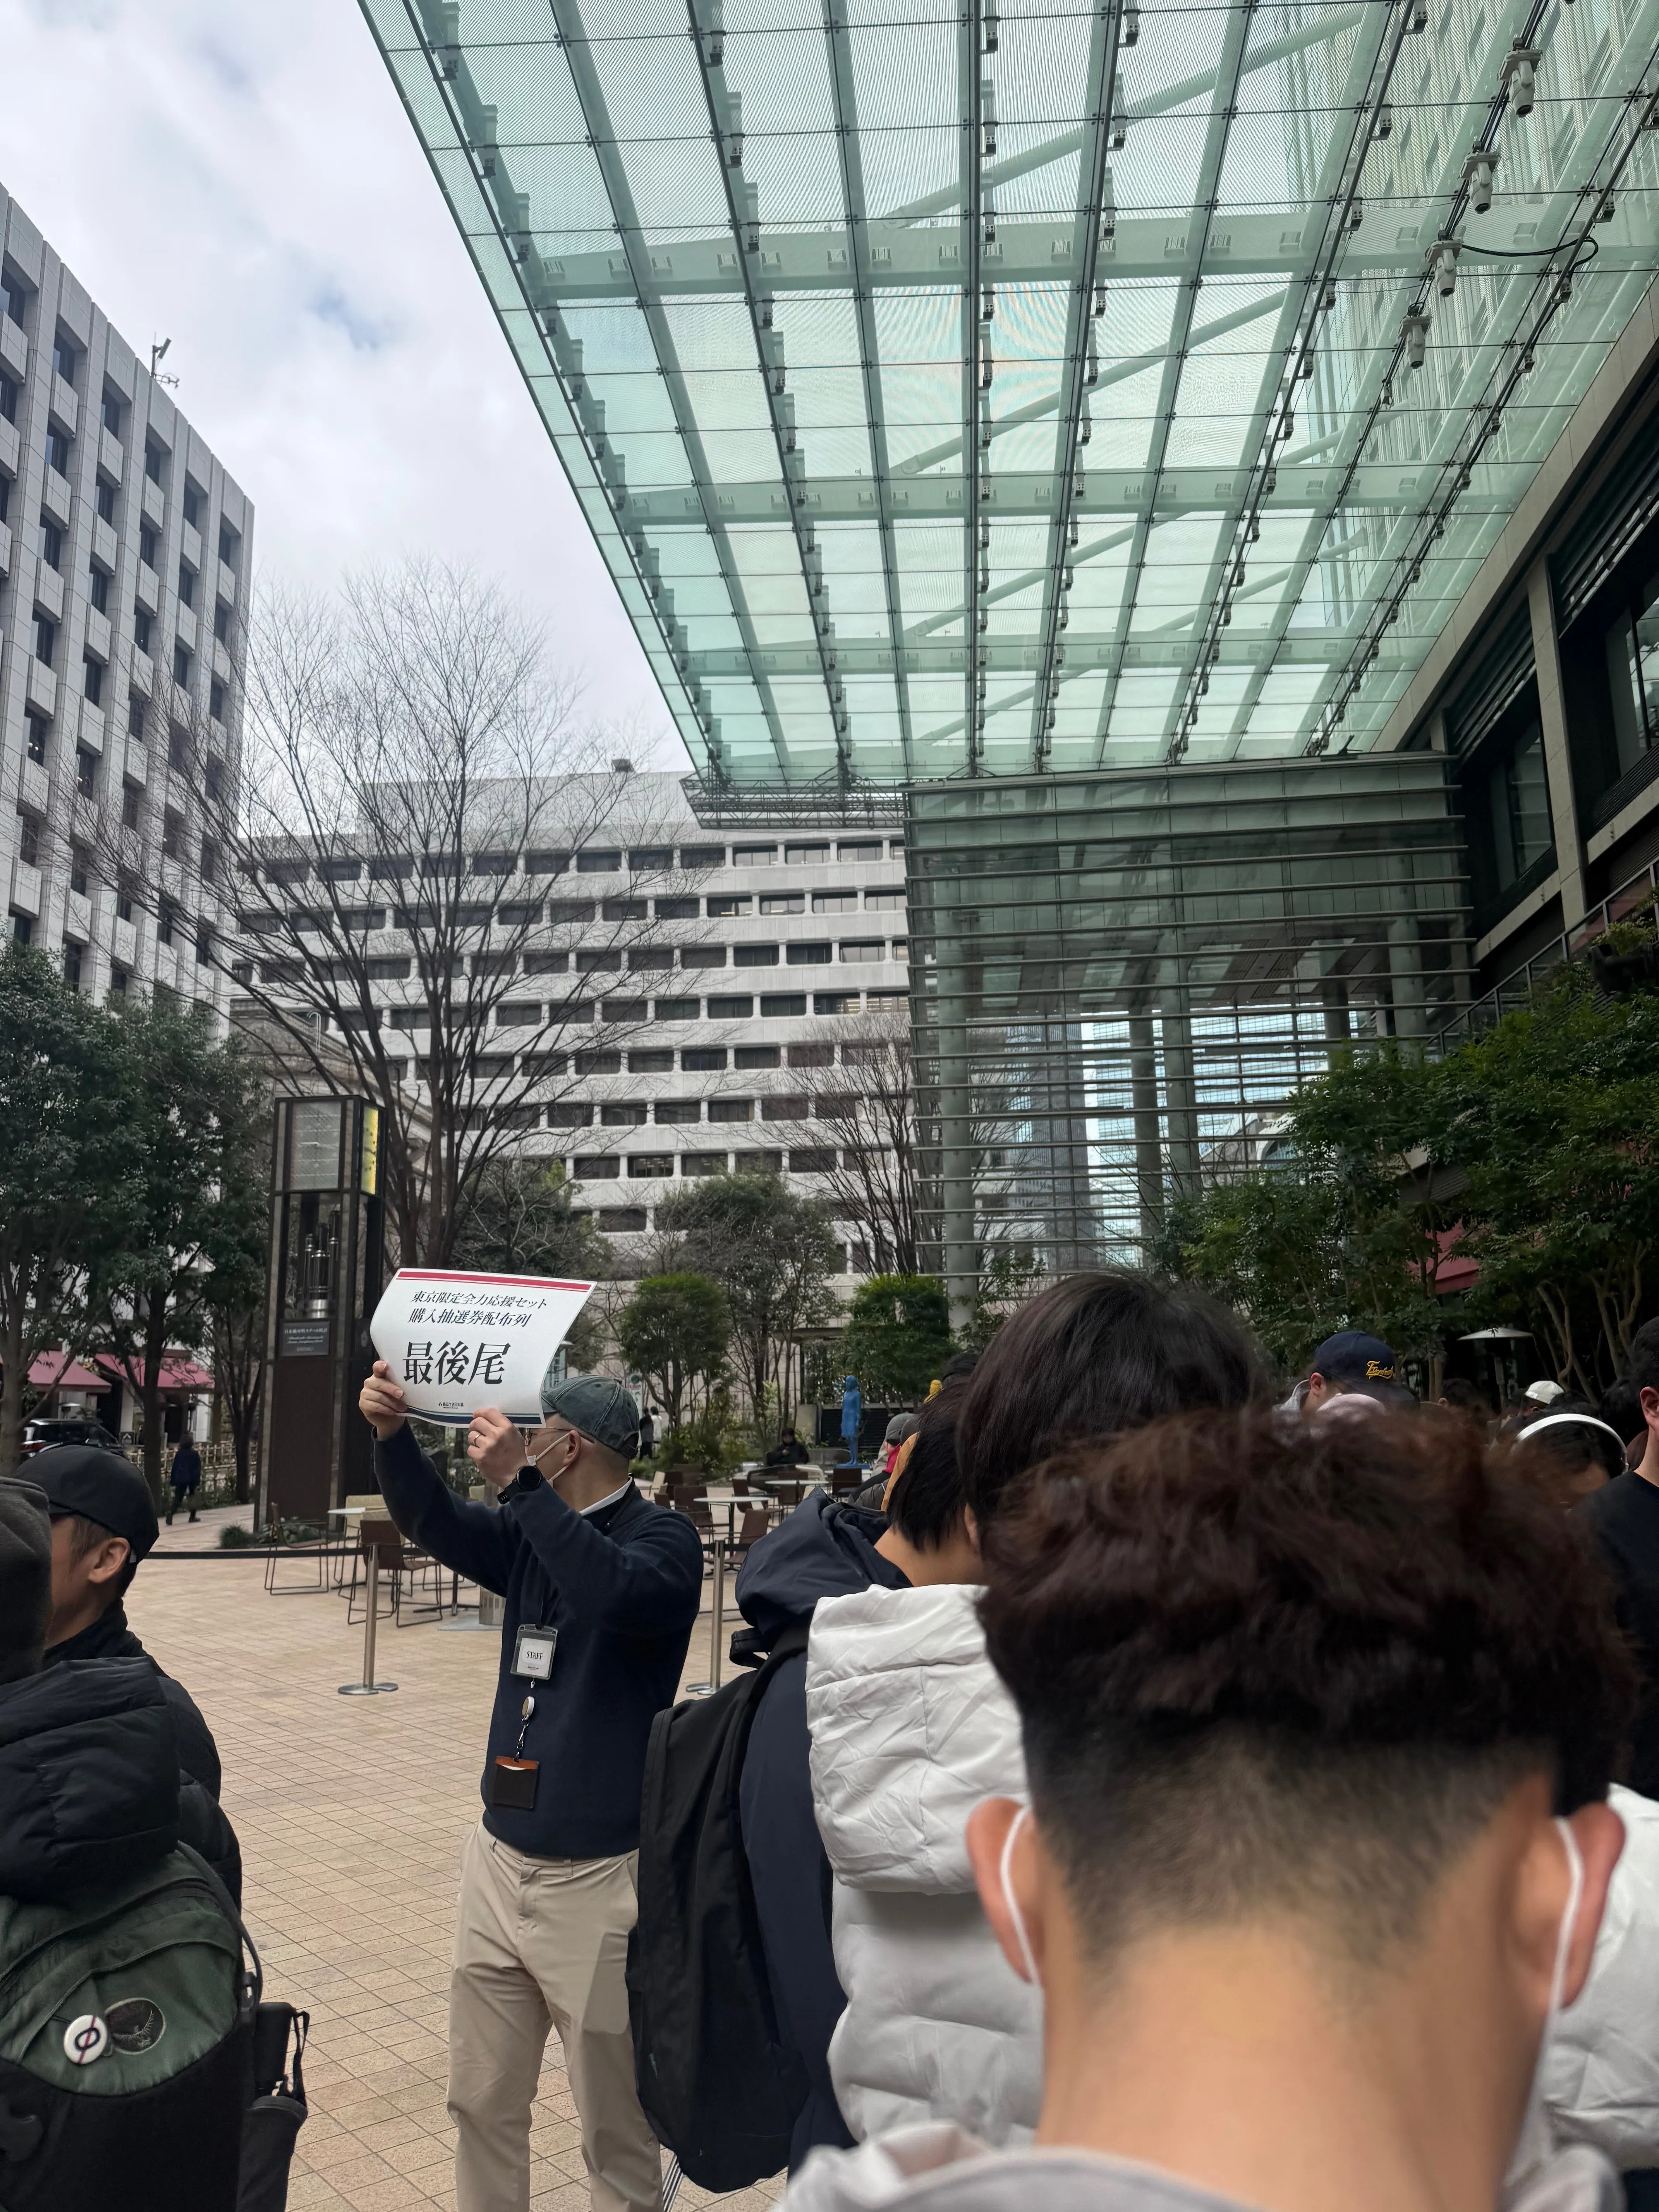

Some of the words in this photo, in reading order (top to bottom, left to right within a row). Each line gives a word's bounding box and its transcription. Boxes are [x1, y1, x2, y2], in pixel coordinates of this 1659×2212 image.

[410, 1290, 547, 1309] 東京限定全力応援セット
[407, 1308, 532, 1327] 購入抽選券配布列
[402, 1341, 511, 1385] 最後尾
[526, 1651, 543, 1660] STAFF
